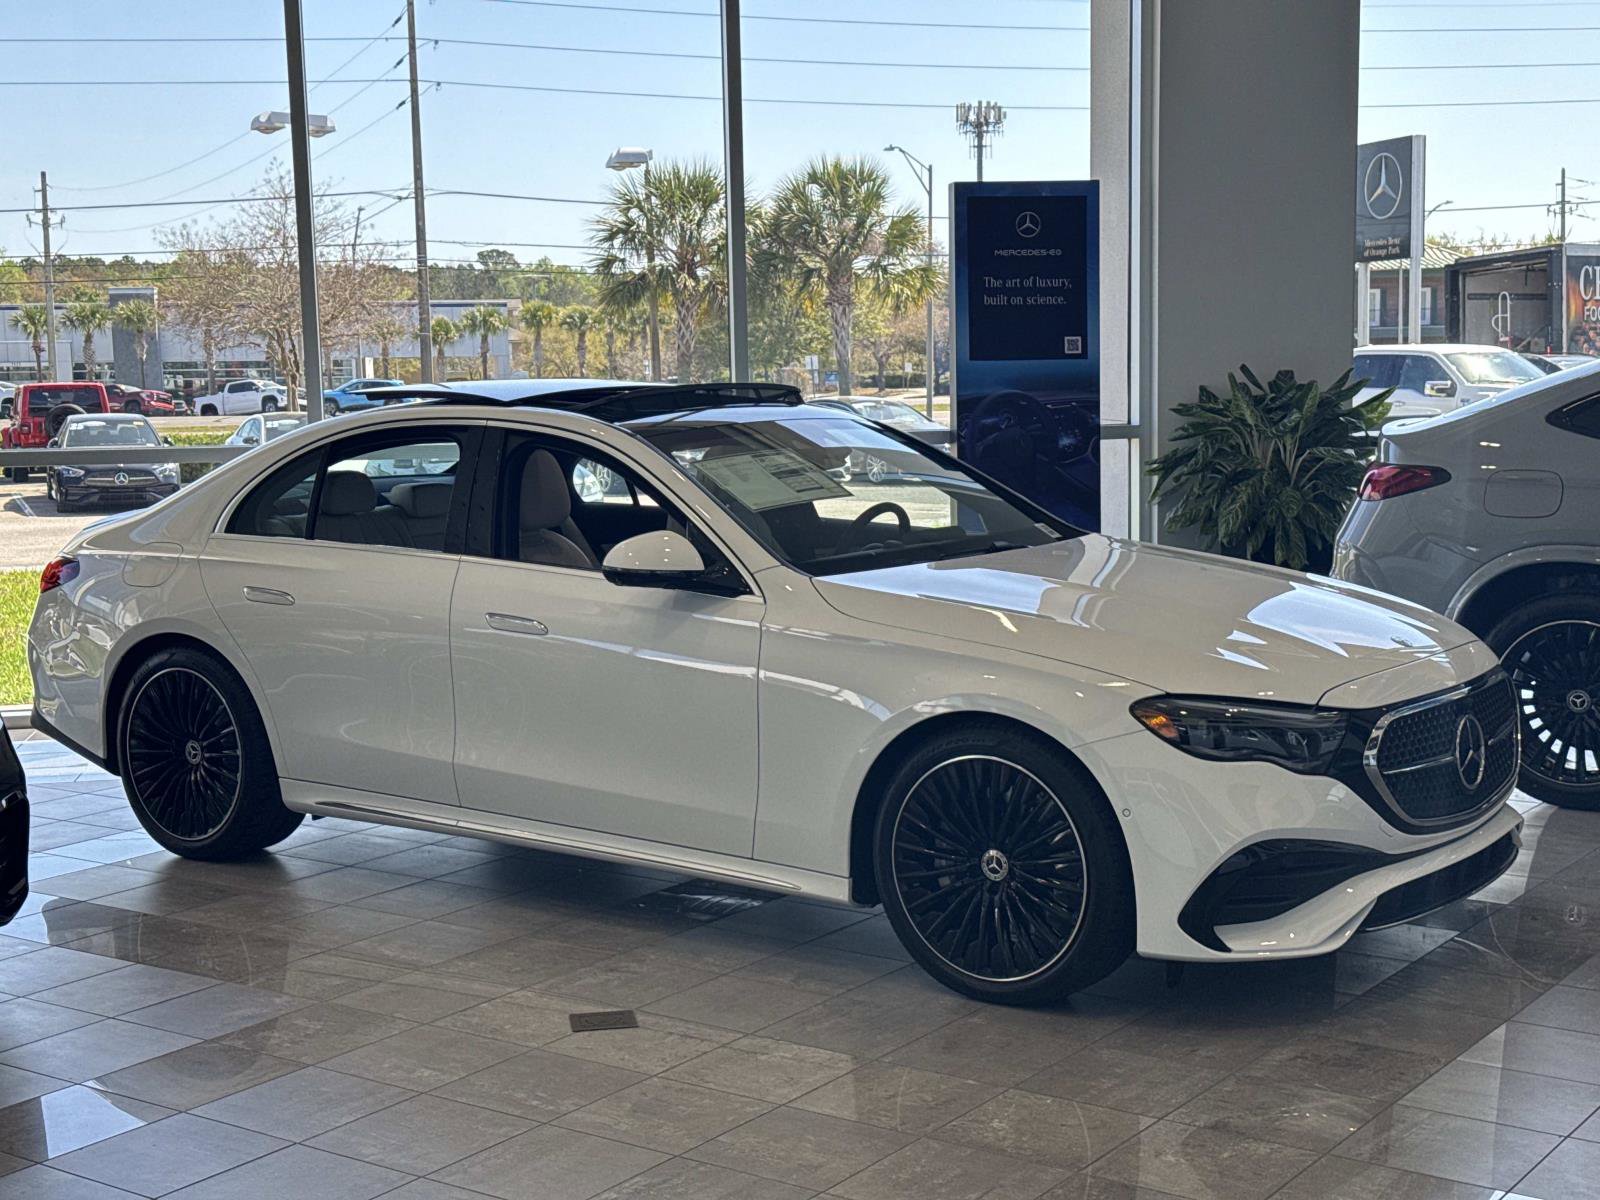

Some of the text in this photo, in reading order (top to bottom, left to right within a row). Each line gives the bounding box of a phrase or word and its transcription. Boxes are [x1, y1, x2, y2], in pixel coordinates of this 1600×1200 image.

[984, 276, 1072, 289] The art of luxury,
[984, 294, 1067, 306] built on science.
